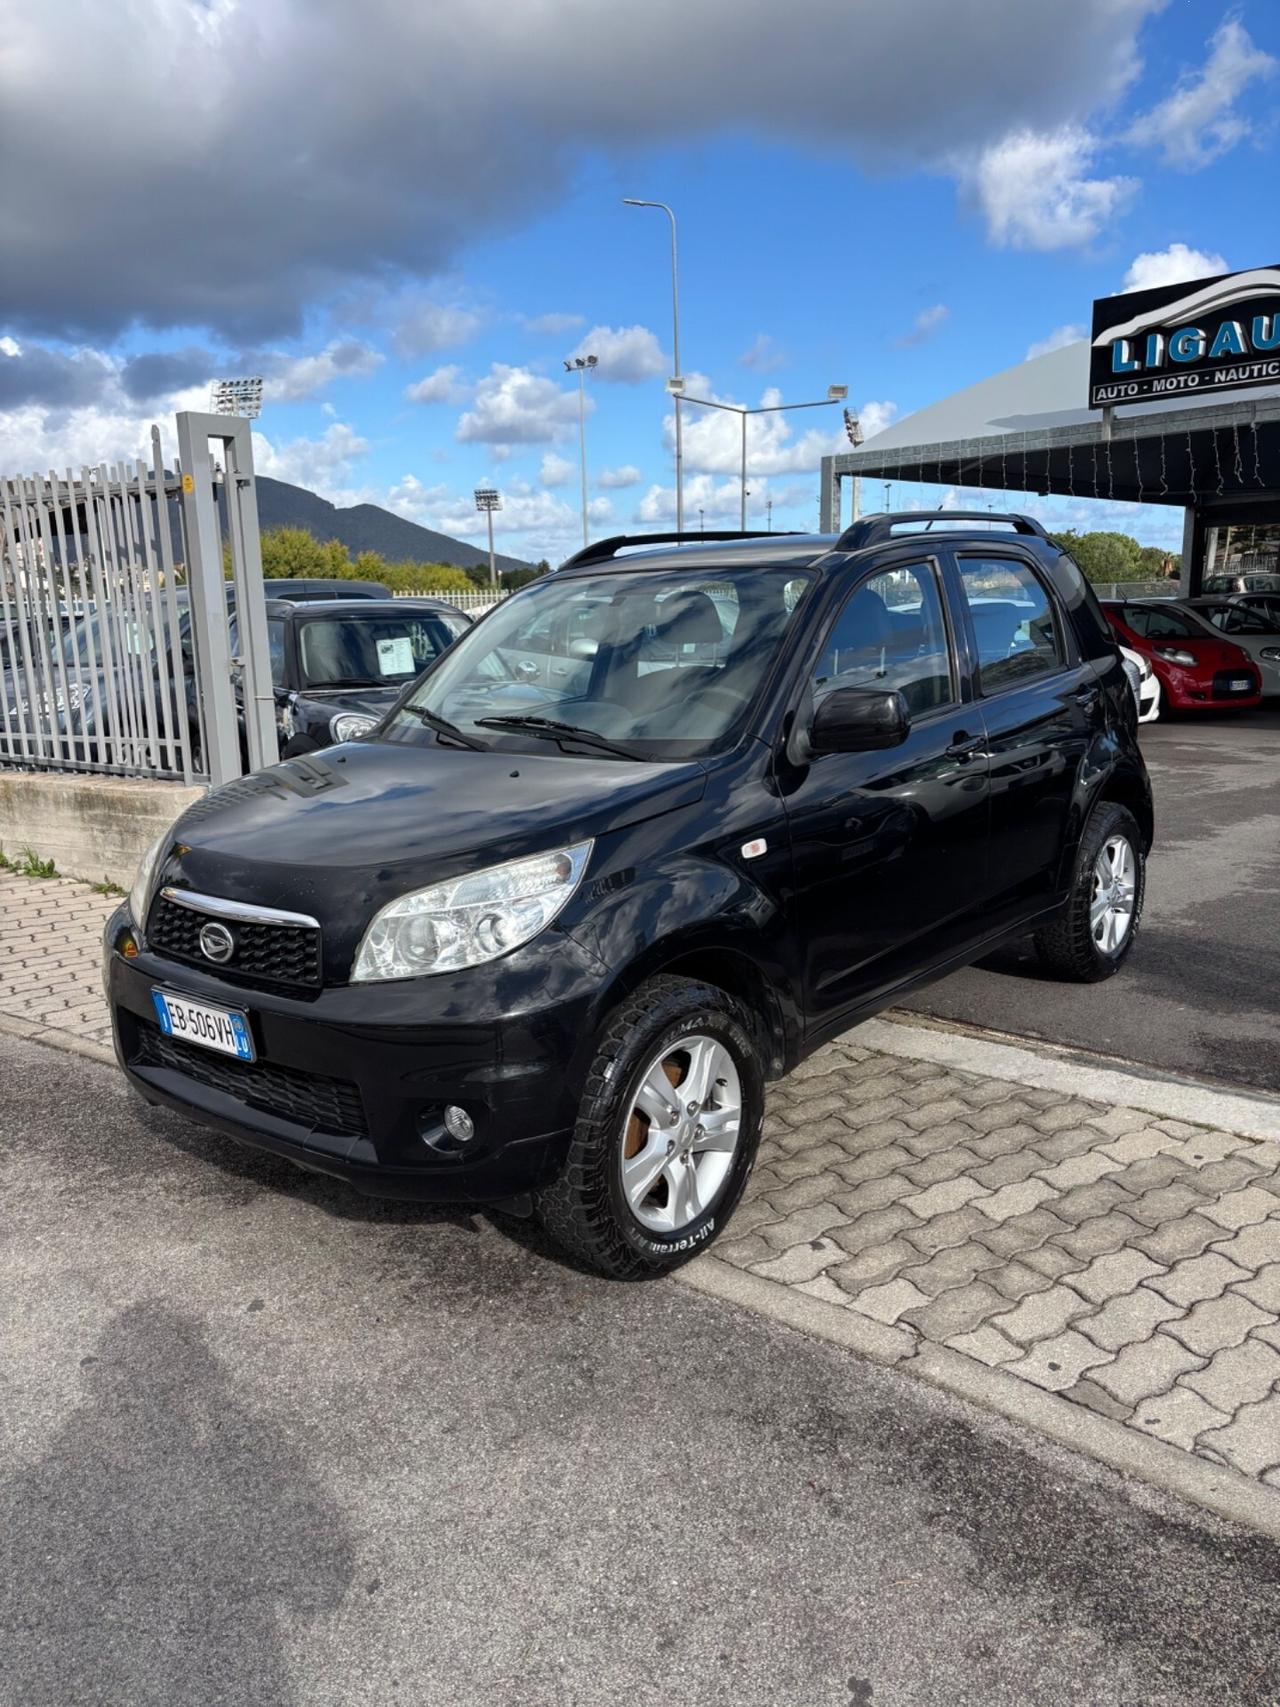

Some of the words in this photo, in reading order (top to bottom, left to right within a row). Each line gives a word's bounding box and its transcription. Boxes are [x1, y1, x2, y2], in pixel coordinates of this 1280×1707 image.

[1112, 313, 1280, 373] LIGAU
[1096, 383, 1138, 400] AUTO
[1152, 374, 1199, 392] MOTO
[1214, 361, 1280, 383] NAUTIC
